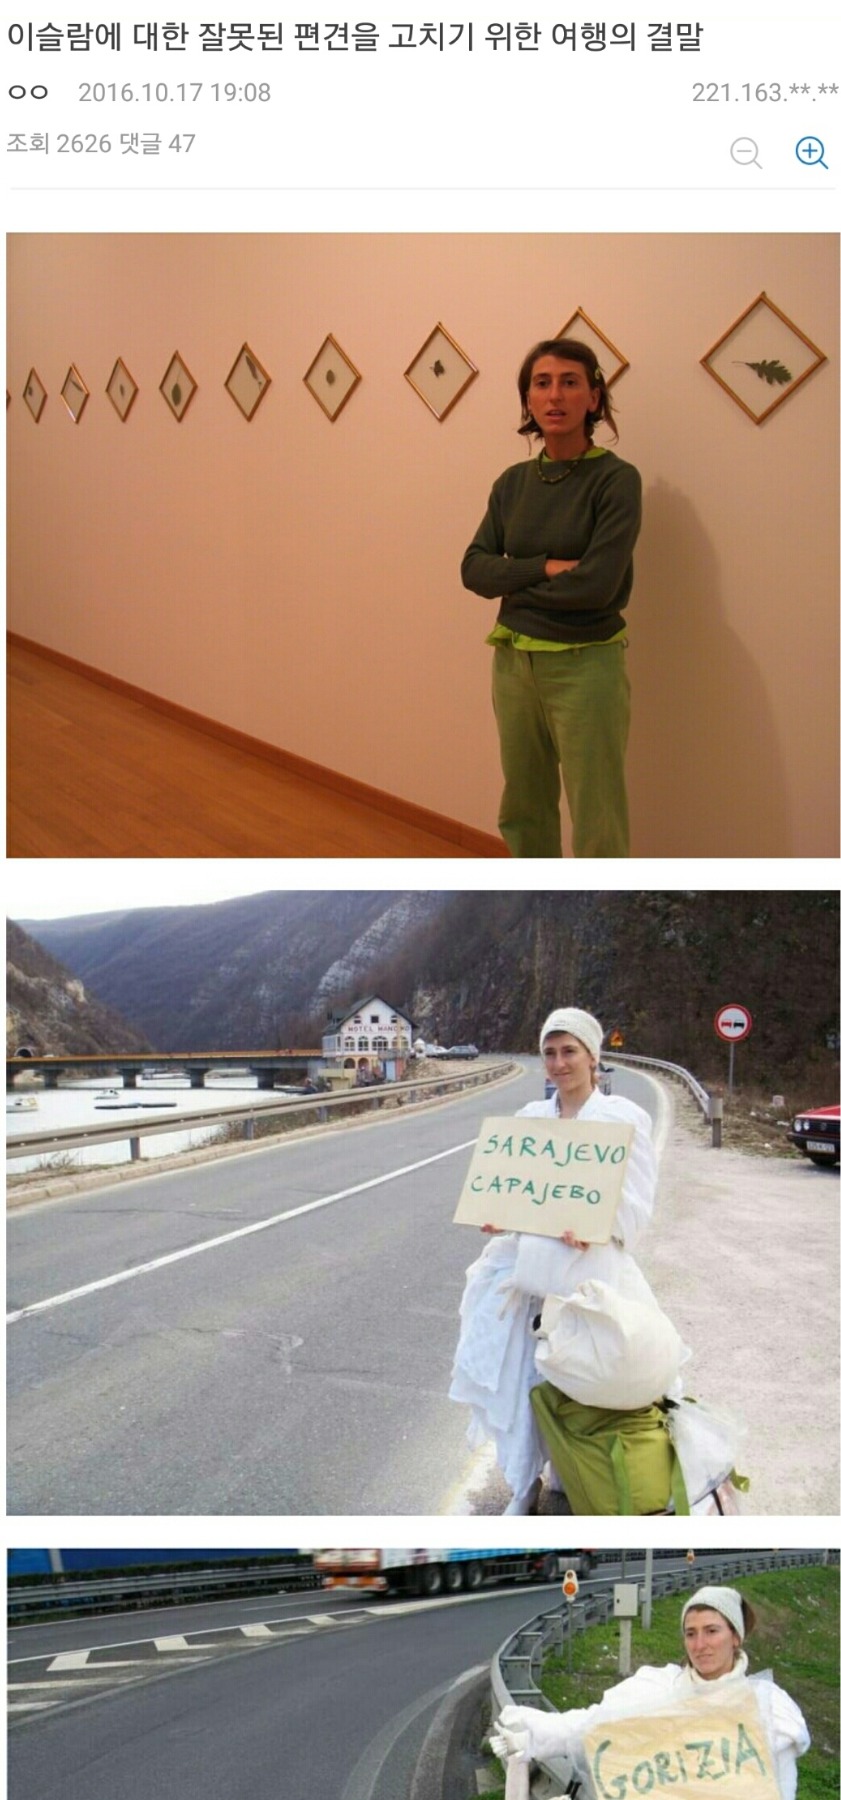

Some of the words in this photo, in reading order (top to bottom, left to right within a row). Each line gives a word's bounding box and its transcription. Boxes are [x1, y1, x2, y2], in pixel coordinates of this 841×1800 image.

[7, 22, 121, 52] 이슬람에
[133, 22, 190, 52] 대한
[198, 22, 283, 52] 잘못된
[294, 22, 380, 52] 편견을
[388, 22, 473, 52] 고치기
[484, 22, 542, 52] 위한
[551, 22, 636, 52] 여행의
[646, 22, 704, 52] 결말
[78, 82, 203, 103] 2016.10.17
[210, 82, 271, 103] 19:08
[6, 132, 49, 155] 조회
[57, 133, 112, 154] 2626
[120, 132, 163, 155] 댓글
[169, 133, 196, 153] 47
[483, 1134, 626, 1167] SARAJEVO
